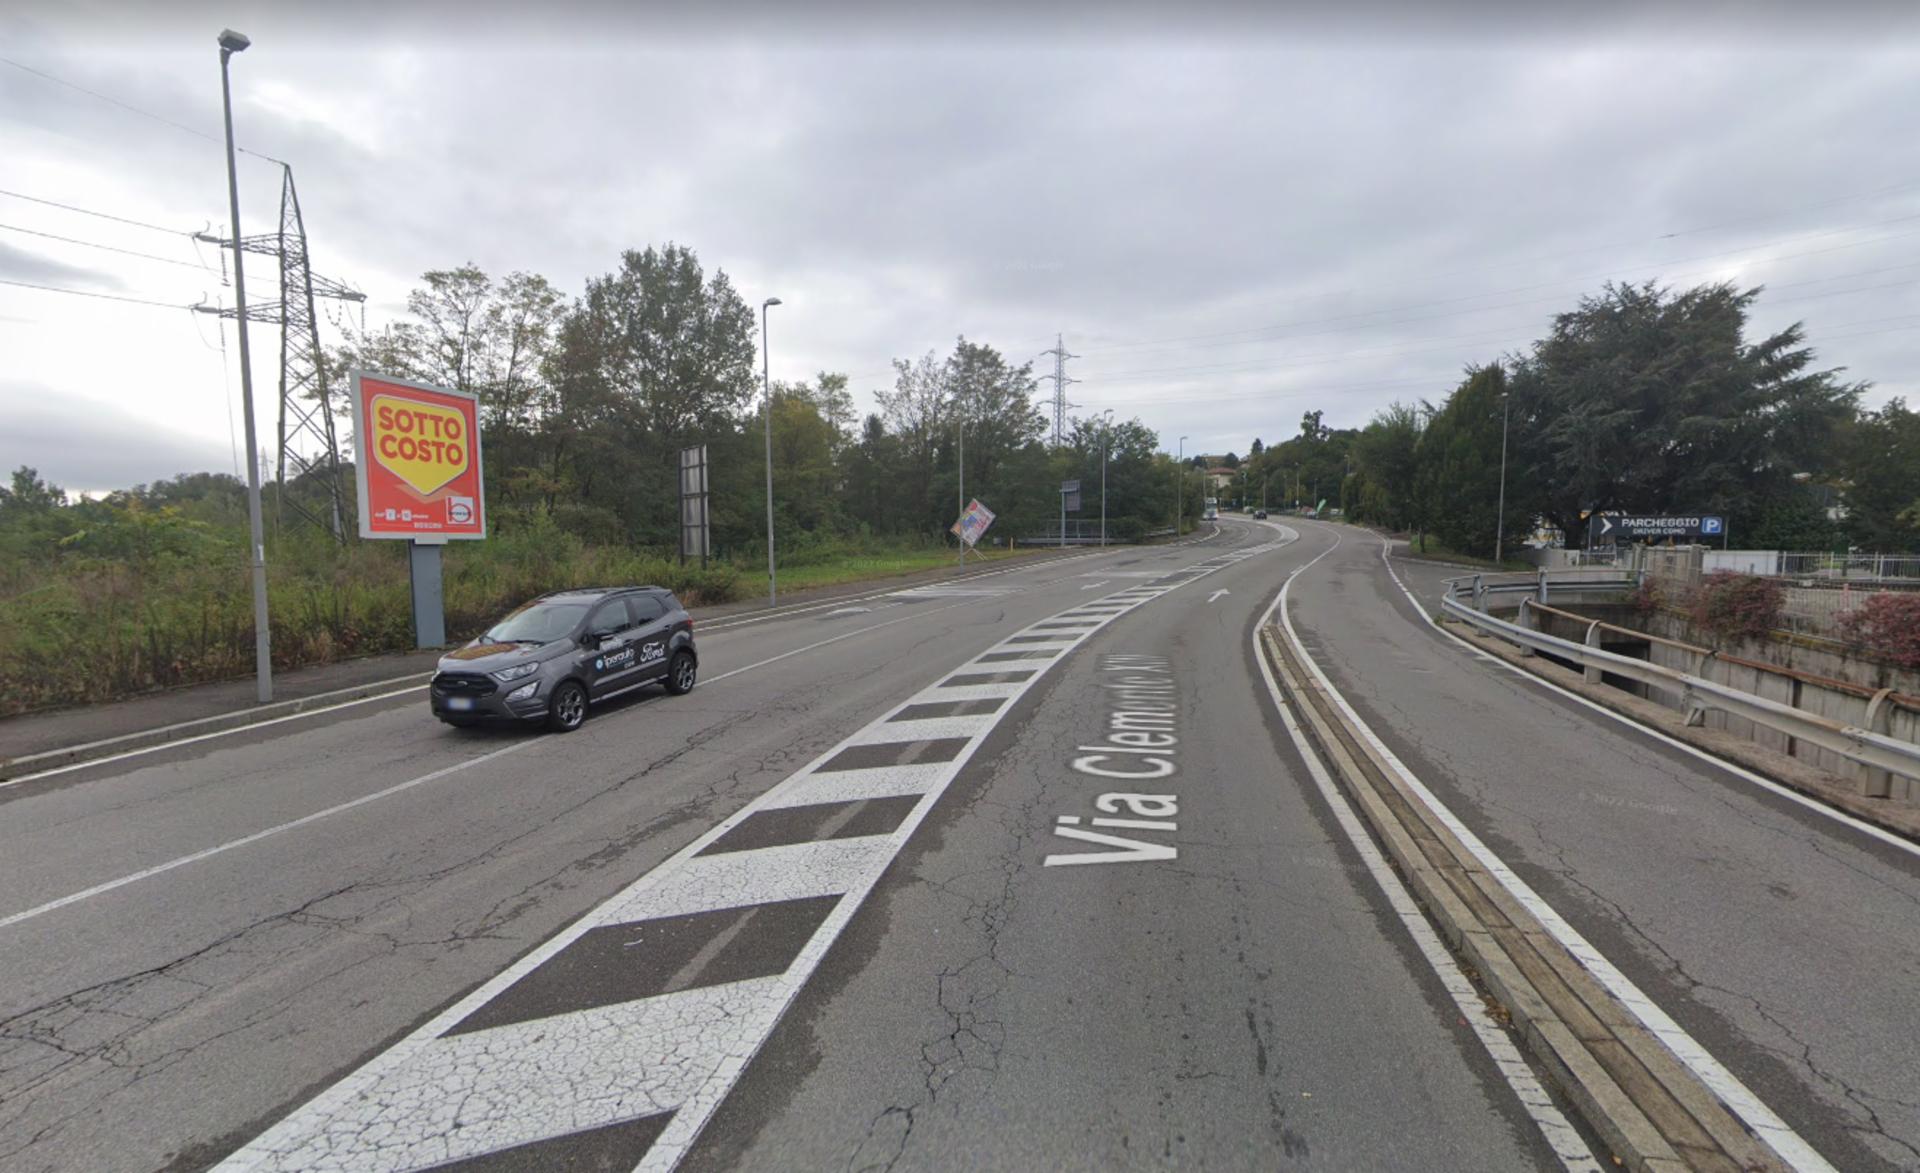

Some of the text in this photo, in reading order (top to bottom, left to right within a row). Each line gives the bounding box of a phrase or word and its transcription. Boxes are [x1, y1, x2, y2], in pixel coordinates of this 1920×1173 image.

[379, 406, 461, 440] SOTTO
[380, 434, 463, 466] COSTO
[1622, 517, 1699, 528] PARCHEGGIO
[640, 641, 665, 662] Ford
